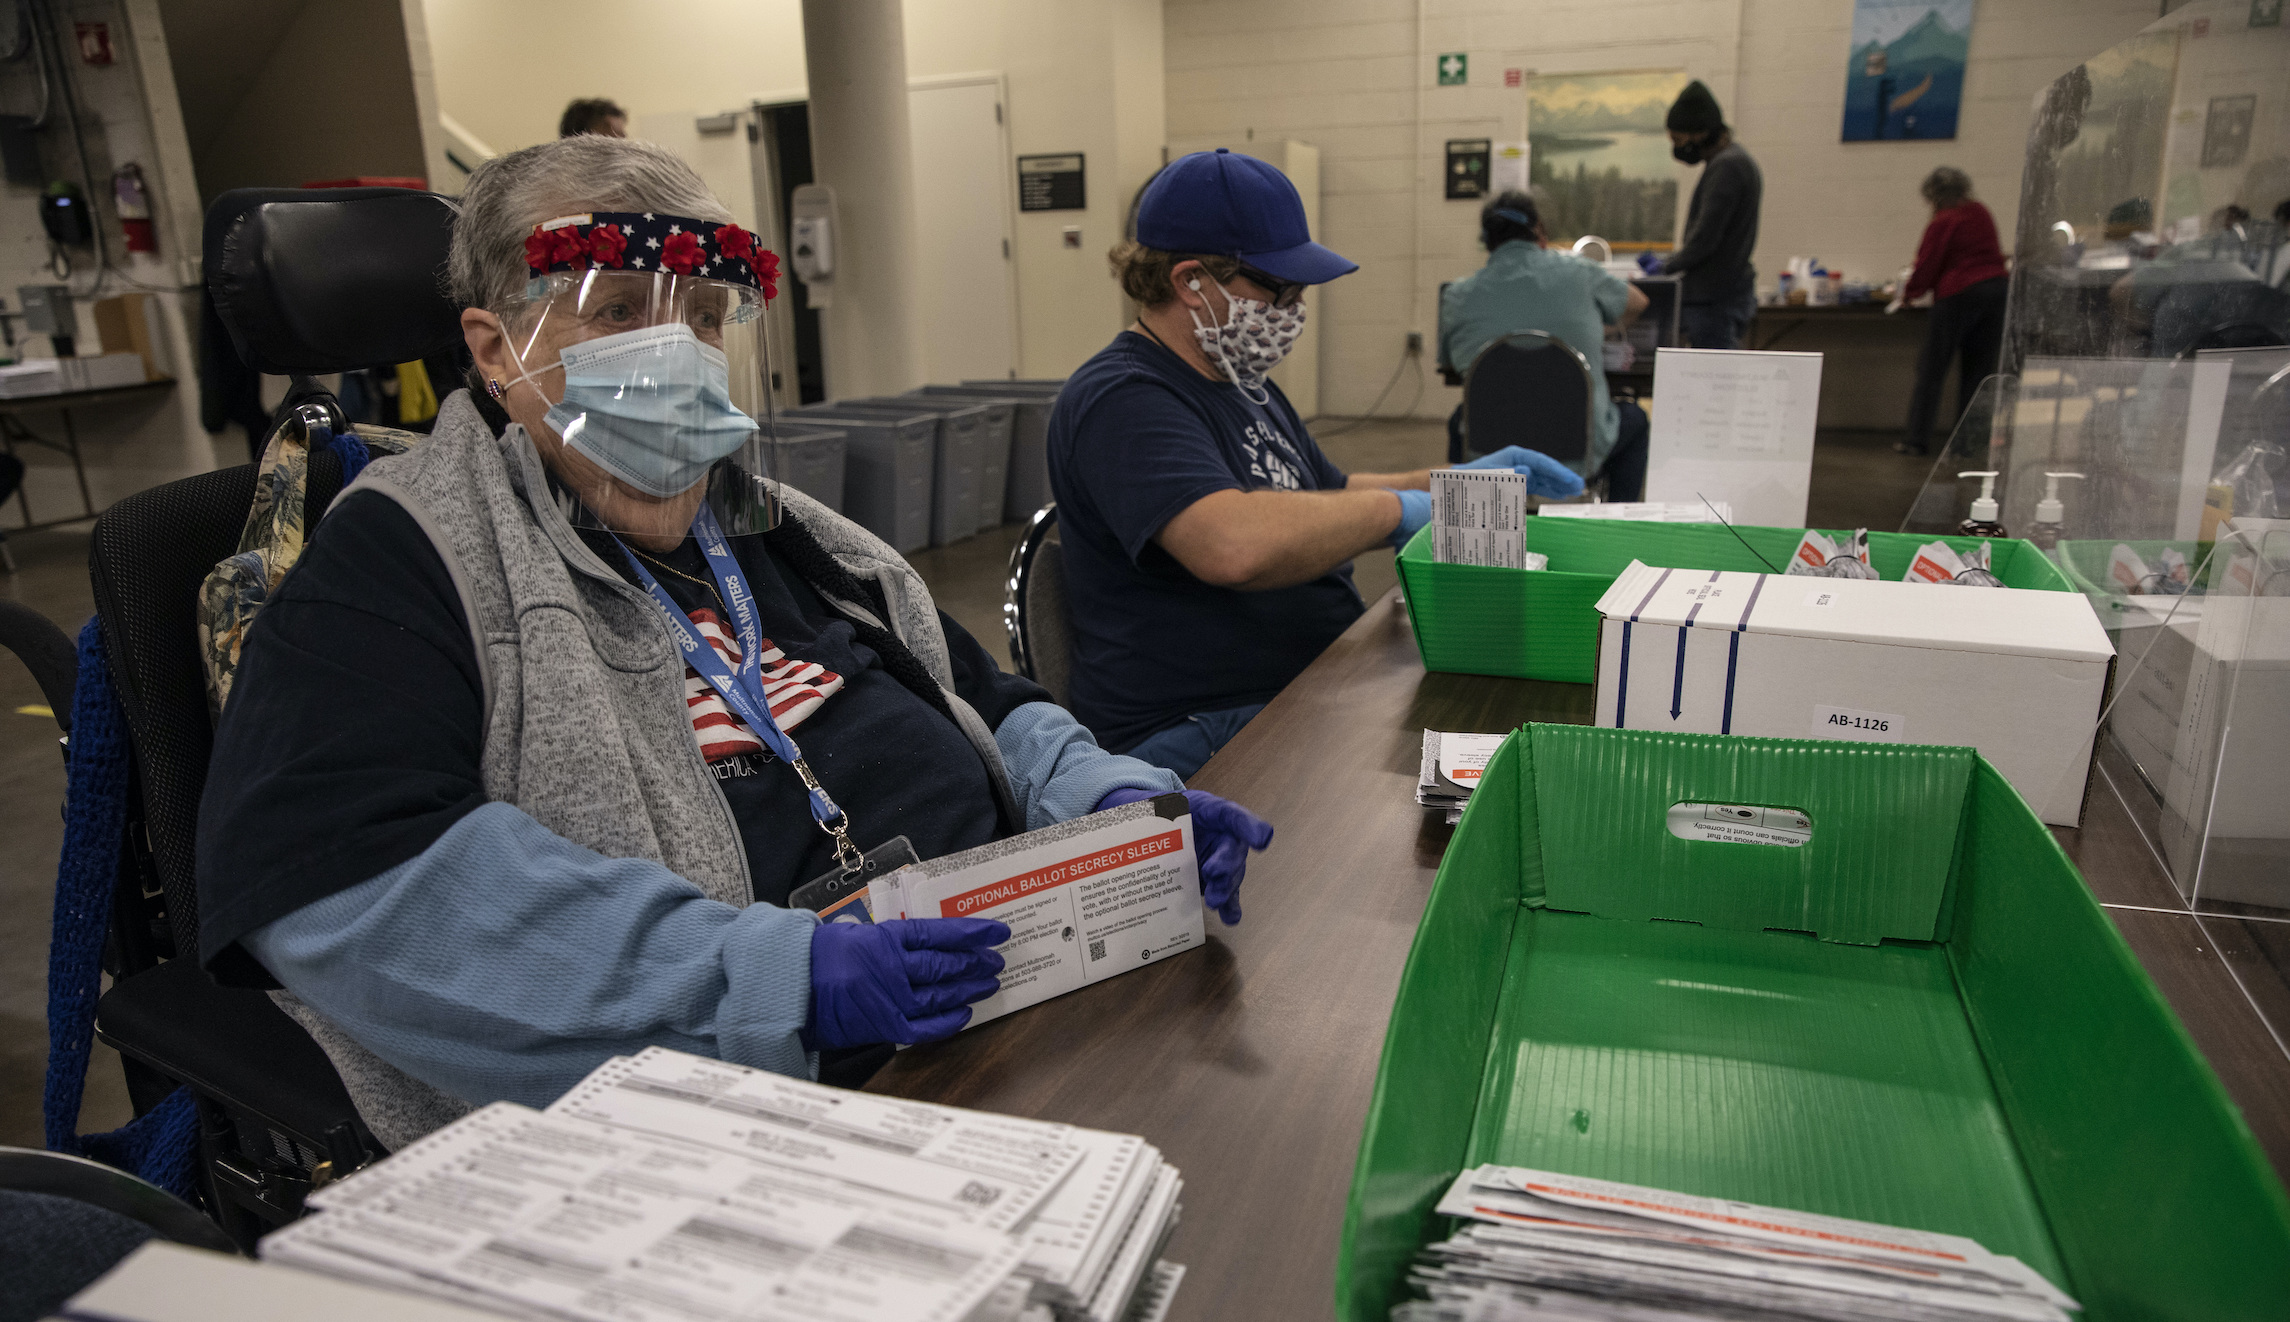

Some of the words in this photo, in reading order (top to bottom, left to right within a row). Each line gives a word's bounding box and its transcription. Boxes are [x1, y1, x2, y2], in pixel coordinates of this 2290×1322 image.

[725, 575, 754, 629] MATTERS
[728, 693, 750, 716] County
[732, 688, 762, 724] Multnomah
[1828, 714, 1890, 732] AB-1126
[1692, 822, 1726, 832] correctly.
[1735, 828, 1754, 836] count
[1734, 836, 1762, 846] obvious
[1771, 836, 1800, 846] officials
[956, 884, 1018, 912] OPTIONAL
[1020, 868, 1066, 891] BALLOT
[1070, 850, 1124, 876] SECRECY
[1127, 837, 1171, 859] SLEEVE
[1079, 884, 1092, 893] The
[1092, 878, 1110, 890] ballot
[1111, 871, 1136, 885] opening
[1137, 864, 1161, 878] process
[1080, 890, 1106, 902] ensures
[1106, 884, 1117, 894] the
[1118, 872, 1159, 890] confidentiality
[1160, 870, 1167, 878] of
[1167, 866, 1181, 880] your
[1082, 900, 1098, 912] vote,
[1099, 895, 1112, 906] with
[1120, 887, 1143, 900] without
[1144, 883, 1154, 893] the
[1154, 880, 1166, 889] use
[1166, 877, 1173, 886] of
[1084, 910, 1094, 920] the
[1095, 902, 1120, 917] optional
[1120, 898, 1138, 911] ballot
[1138, 890, 1161, 904] secrecy
[1162, 884, 1184, 897] sleeve.
[1014, 906, 1027, 914] must
[1035, 898, 1052, 908] signed
[1016, 911, 1037, 923] counted.
[1012, 928, 1035, 940] accepted.
[1049, 918, 1063, 928] ballot
[1086, 928, 1099, 937] Watch
[1103, 922, 1114, 932] video
[1126, 916, 1137, 924] ballot
[1137, 911, 1152, 921] opening
[1011, 942, 1017, 950] by
[1030, 934, 1039, 942] PM
[1039, 928, 1059, 938] election
[1167, 940, 1182, 949] Recycled
[1008, 962, 1027, 973] contact
[1027, 952, 1055, 966] Multnomah
